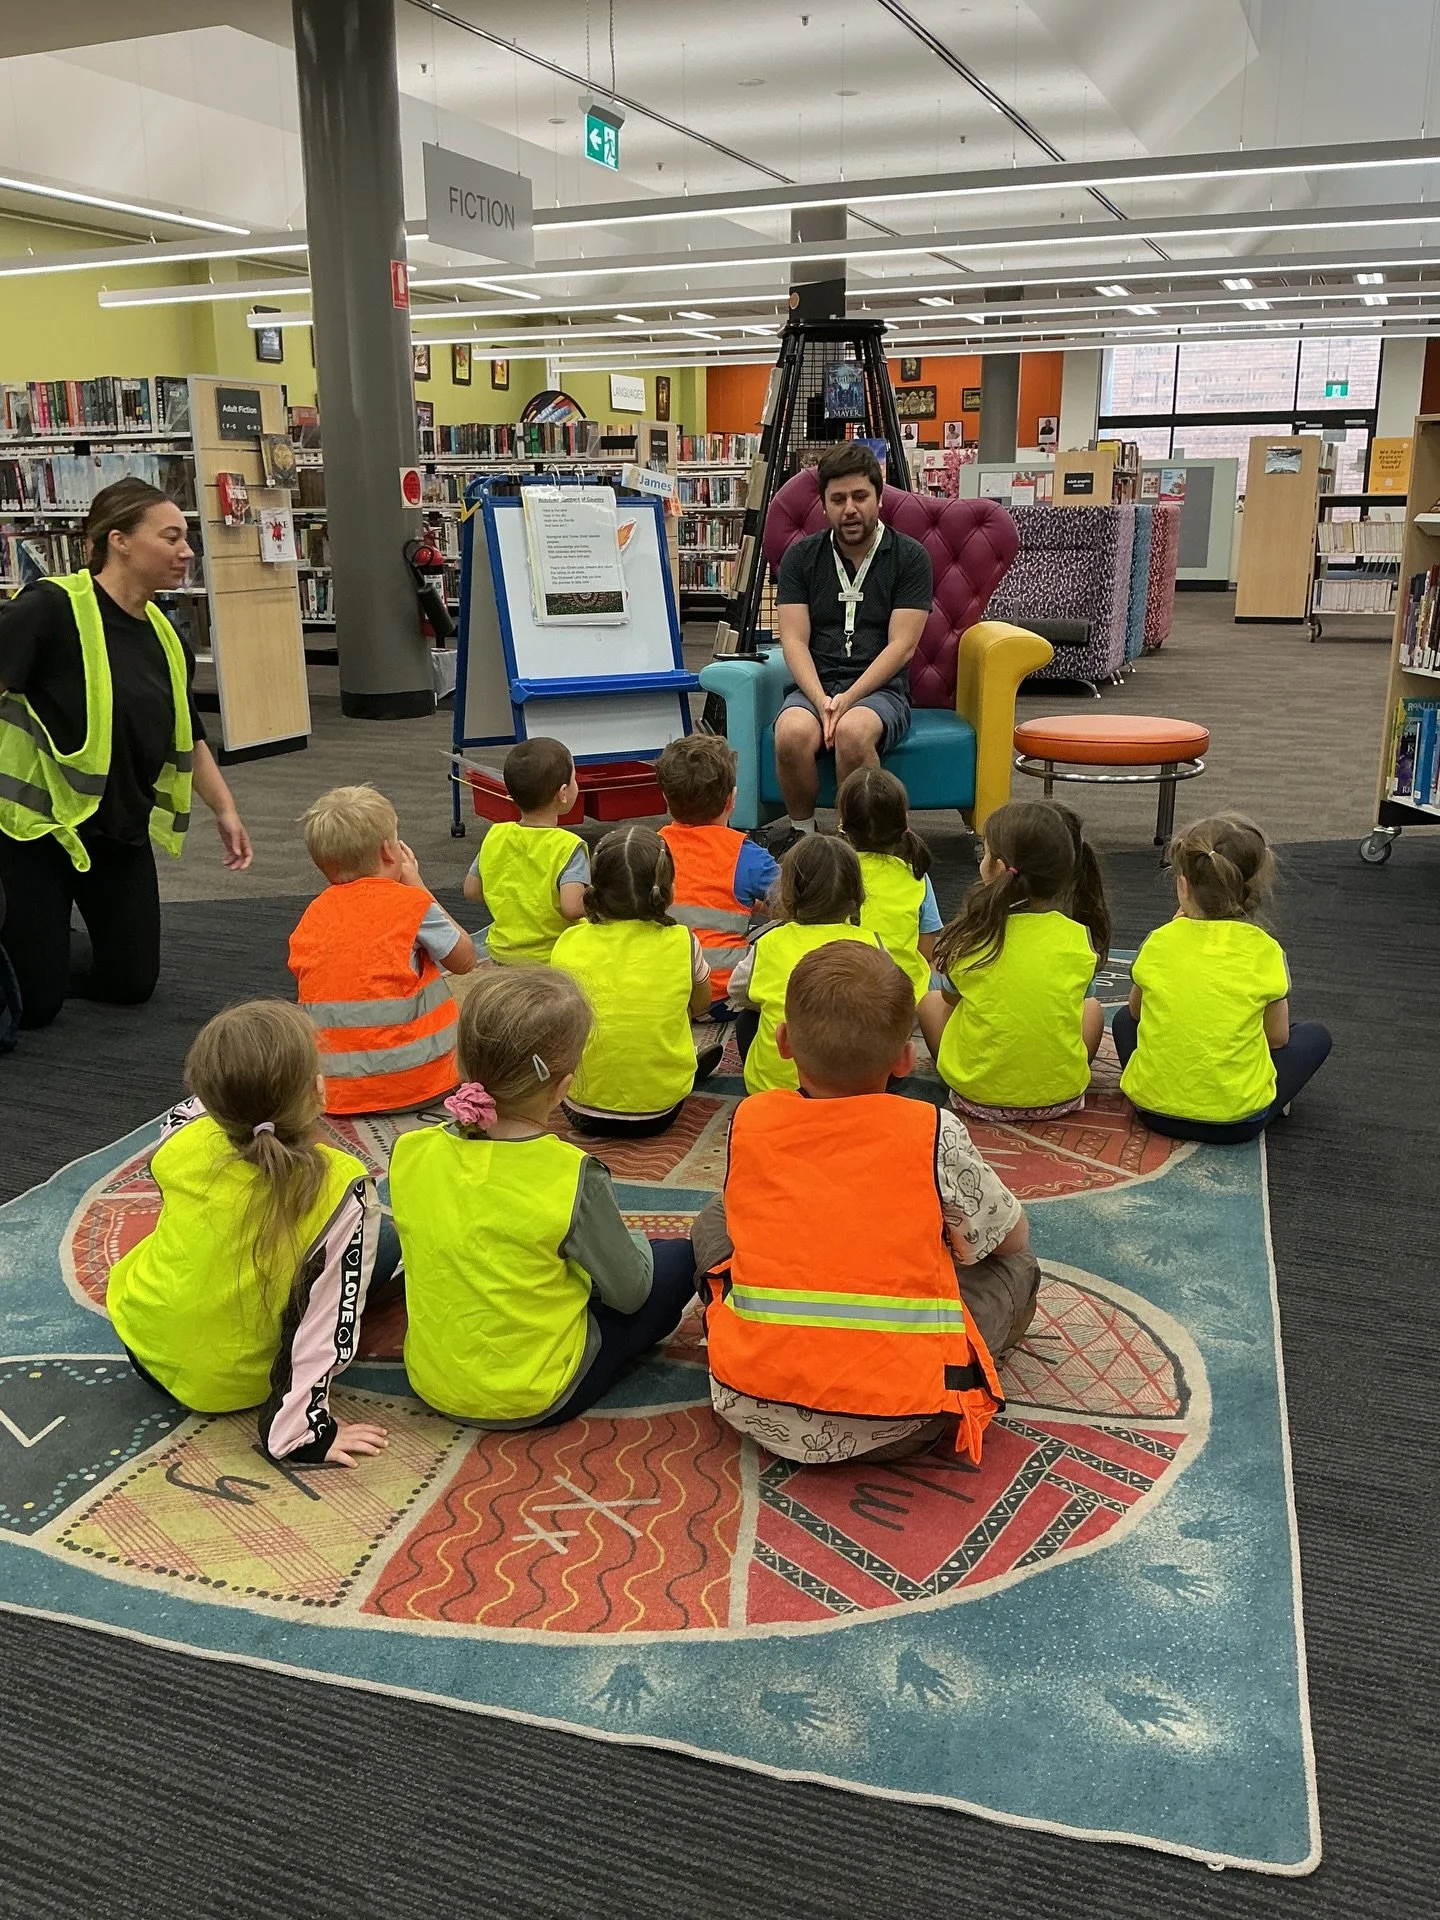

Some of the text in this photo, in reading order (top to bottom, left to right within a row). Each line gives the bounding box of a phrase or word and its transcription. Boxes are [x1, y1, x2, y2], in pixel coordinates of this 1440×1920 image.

[449, 186, 515, 231] FICTION
[612, 386, 645, 400] LANGUAGES
[222, 404, 257, 414] Adult Fiction
[833, 408, 862, 417] MAYER
[640, 474, 672, 492] James
[341, 1270, 359, 1323] LOVE
